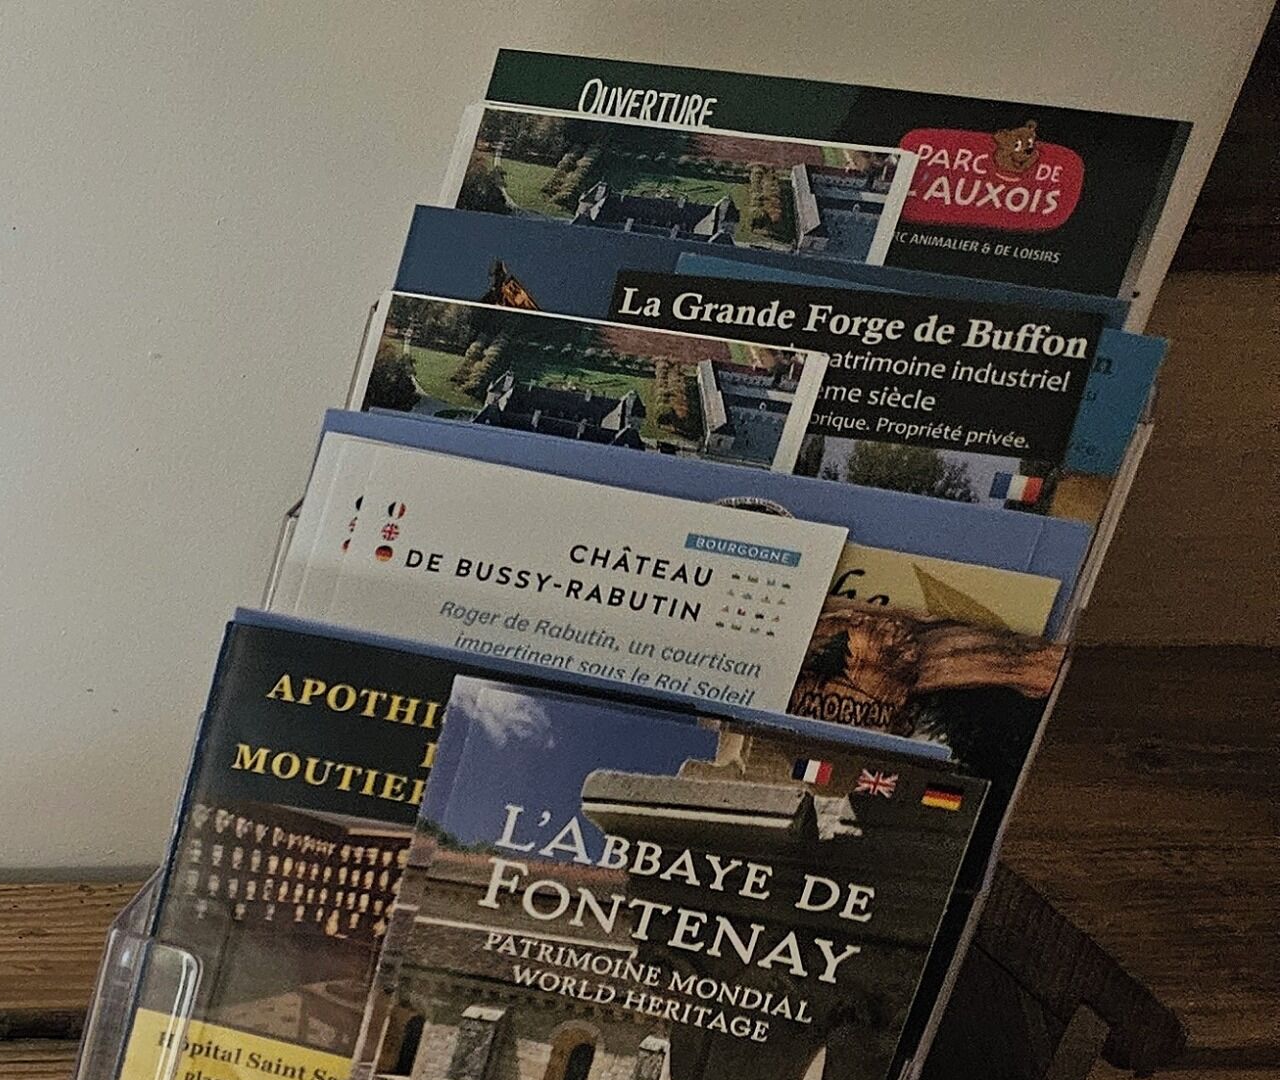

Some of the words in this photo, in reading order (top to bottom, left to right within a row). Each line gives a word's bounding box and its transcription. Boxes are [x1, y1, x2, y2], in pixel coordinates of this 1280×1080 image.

[577, 78, 718, 129] OUVERTURE
[918, 144, 989, 175] PARC
[1035, 165, 1062, 182] DE
[908, 233, 980, 252] ANIMALIER
[981, 243, 992, 255] &
[994, 245, 1012, 257] DE
[1013, 247, 1061, 265] LOISIRS
[619, 287, 661, 318] La
[673, 292, 796, 330] Grande
[803, 305, 907, 345] Forge
[914, 314, 954, 345] de
[962, 317, 1089, 360] Buffon
[829, 351, 946, 380] atrimoine
[951, 359, 1071, 393] industriel
[569, 544, 714, 587] CHÂTEAU
[694, 536, 791, 566] BOURGOGNE
[405, 549, 443, 572] DE
[456, 558, 703, 623] BUSSY-RABUTIN
[439, 600, 499, 629] Roger
[503, 611, 530, 633] de
[534, 616, 621, 652] Rabutin,
[628, 639, 656, 659] un
[660, 644, 762, 679] courtisan
[266, 673, 441, 729] APOTHI
[495, 803, 774, 901] L'ABBAYE
[795, 874, 876, 924] DE
[478, 855, 862, 987] FONTENAY
[483, 931, 662, 989] PATRIMOINE
[668, 972, 813, 1025] MONDIAL
[512, 964, 617, 1003] WORLD
[622, 990, 771, 1044] HERITAGE
